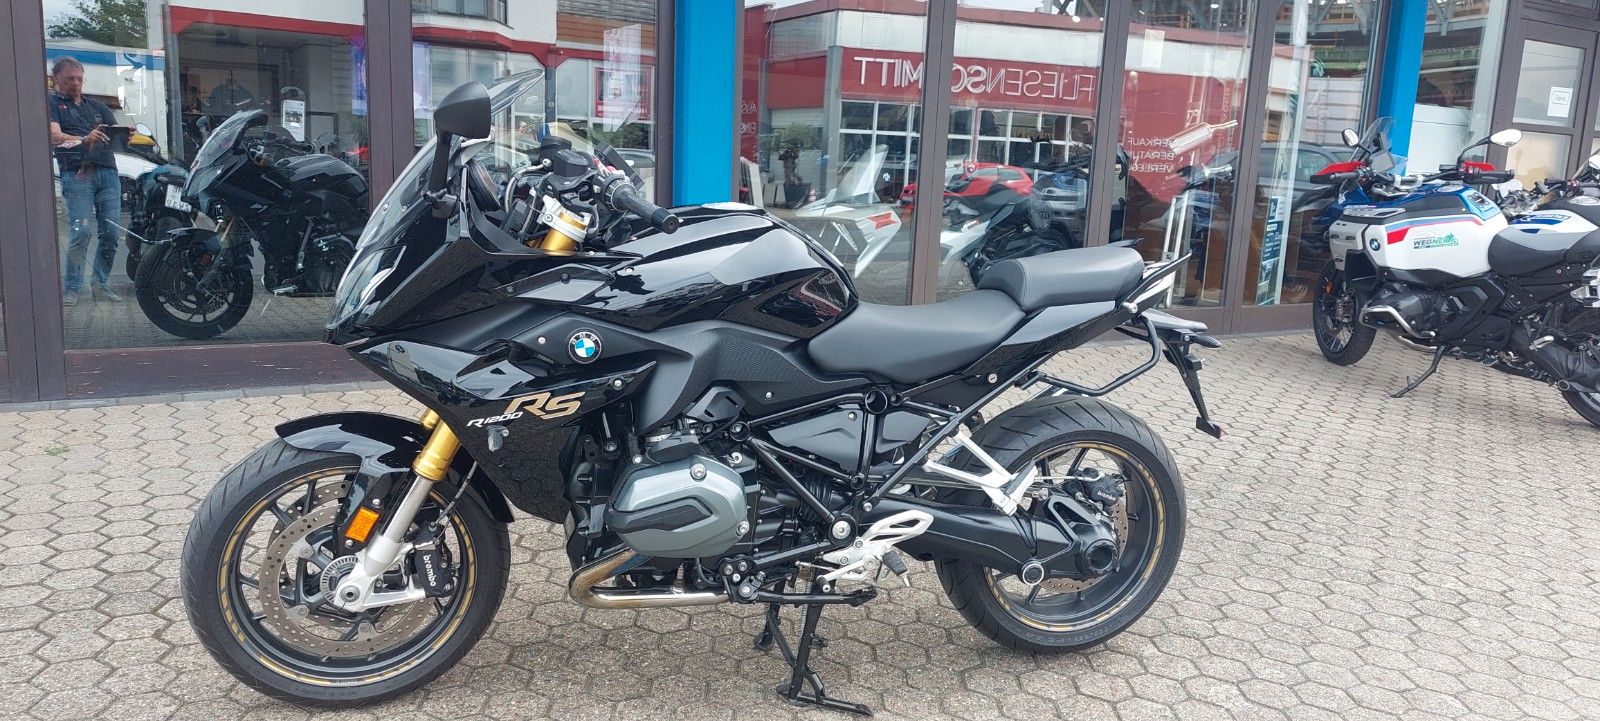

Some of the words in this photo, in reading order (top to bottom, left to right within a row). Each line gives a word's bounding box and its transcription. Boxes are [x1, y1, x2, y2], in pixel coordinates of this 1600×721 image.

[466, 411, 524, 428] R1200
[504, 391, 586, 420] RS
[423, 554, 437, 587] brembo
